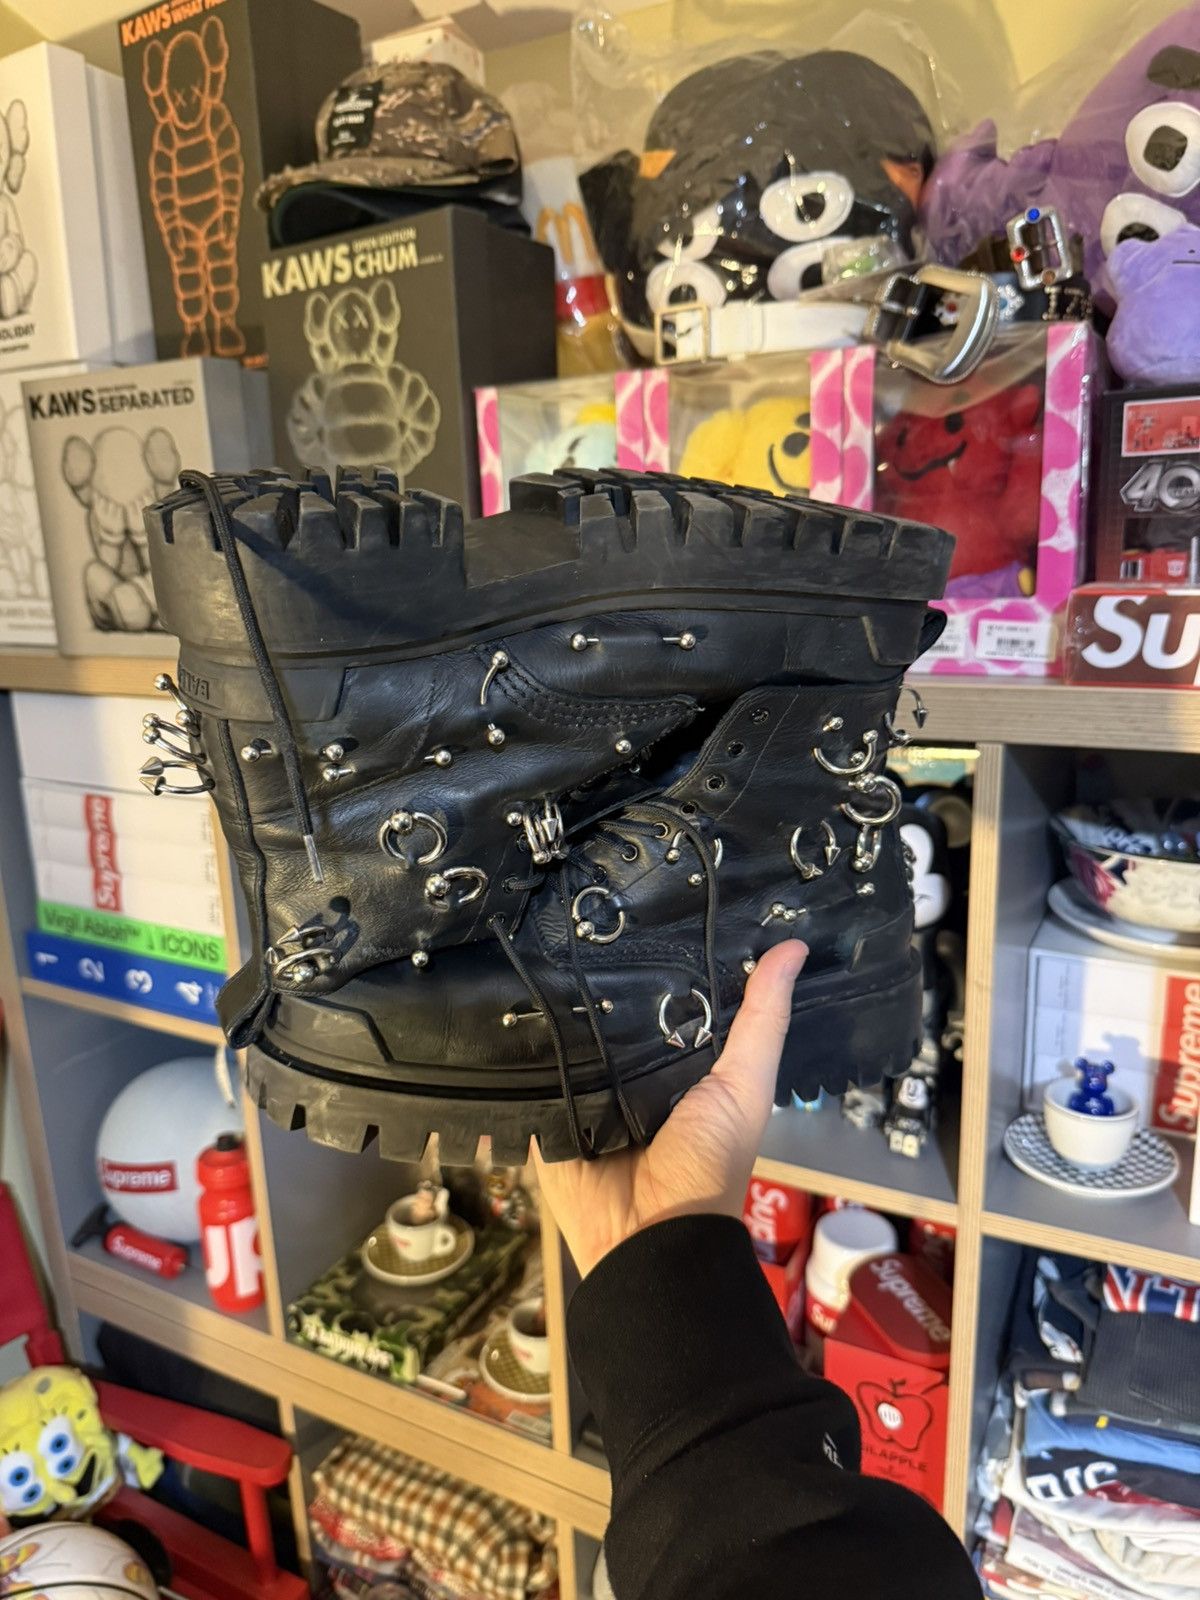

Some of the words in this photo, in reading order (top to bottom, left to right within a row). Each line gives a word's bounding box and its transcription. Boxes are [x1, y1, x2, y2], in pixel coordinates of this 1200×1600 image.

[121, 3, 172, 47] KAWS
[261, 243, 353, 299] KAWS
[353, 242, 419, 279] CHUM
[0, 322, 36, 341] OLIDAY
[28, 388, 97, 421] KAWS
[99, 387, 195, 414] SEPARATED
[1081, 594, 1200, 672] Su
[160, 932, 220, 963] ICONS
[78, 957, 106, 983] 2
[124, 968, 154, 995] 3
[174, 980, 204, 1006] 4
[1157, 981, 1200, 1131] Supreme
[111, 1235, 164, 1272] Supreme
[868, 1257, 953, 1343] Supreme
